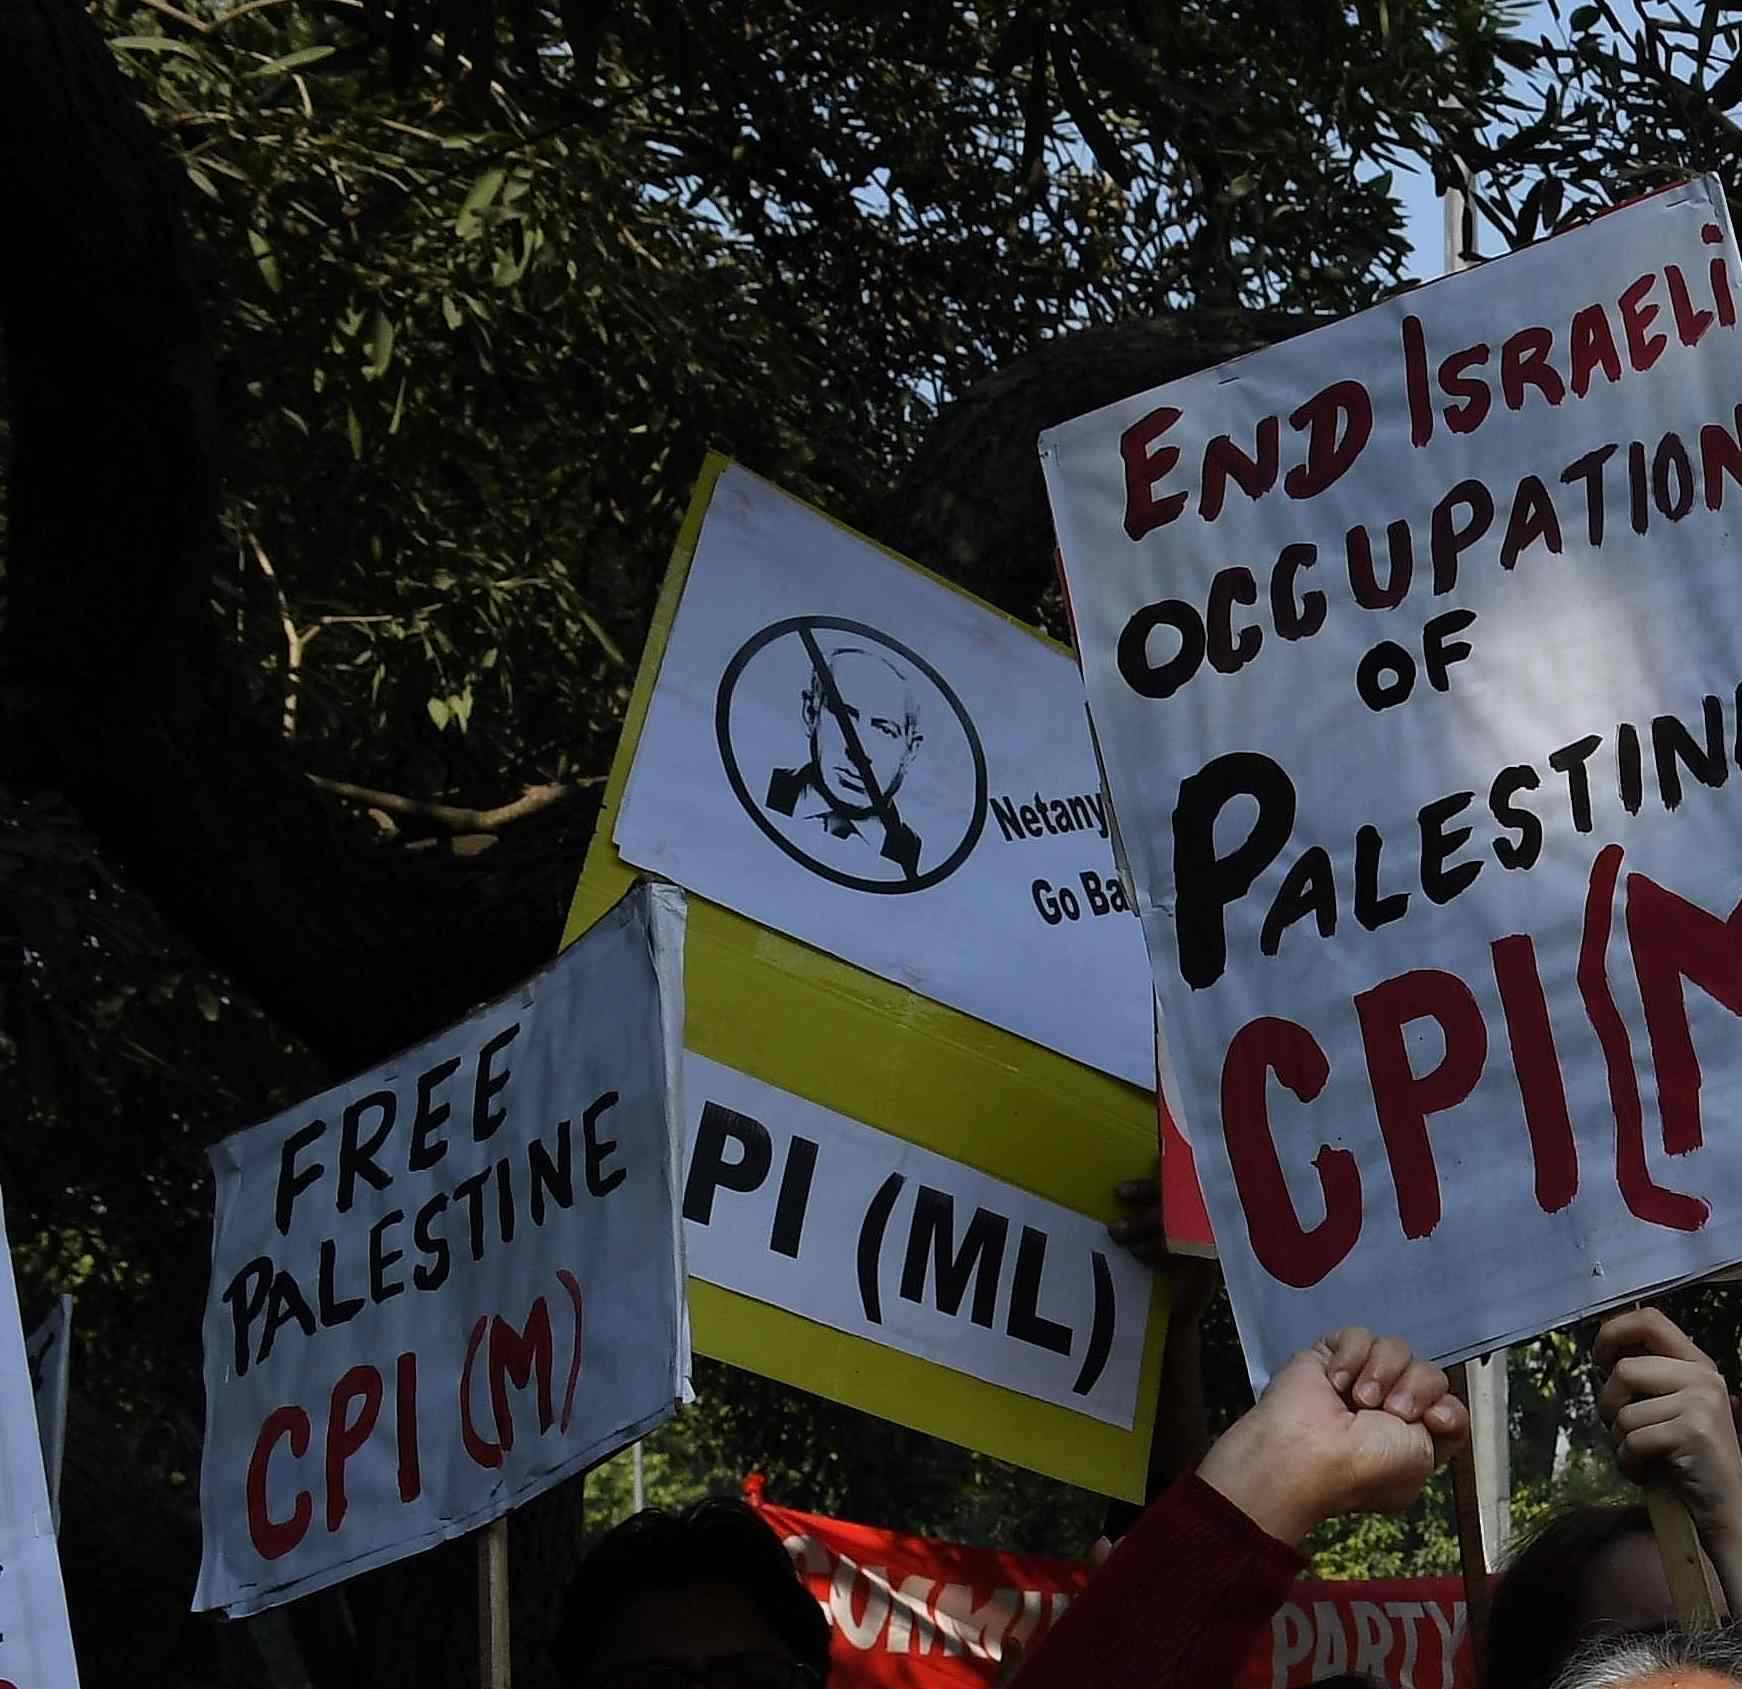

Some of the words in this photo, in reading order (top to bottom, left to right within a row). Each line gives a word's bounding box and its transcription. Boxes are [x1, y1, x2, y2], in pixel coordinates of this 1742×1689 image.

[1121, 377, 1373, 540] END
[1356, 609, 1477, 712] OF
[1032, 879, 1080, 925] Go
[274, 1025, 521, 1236] FREE
[221, 1091, 628, 1378] PALESTINE
